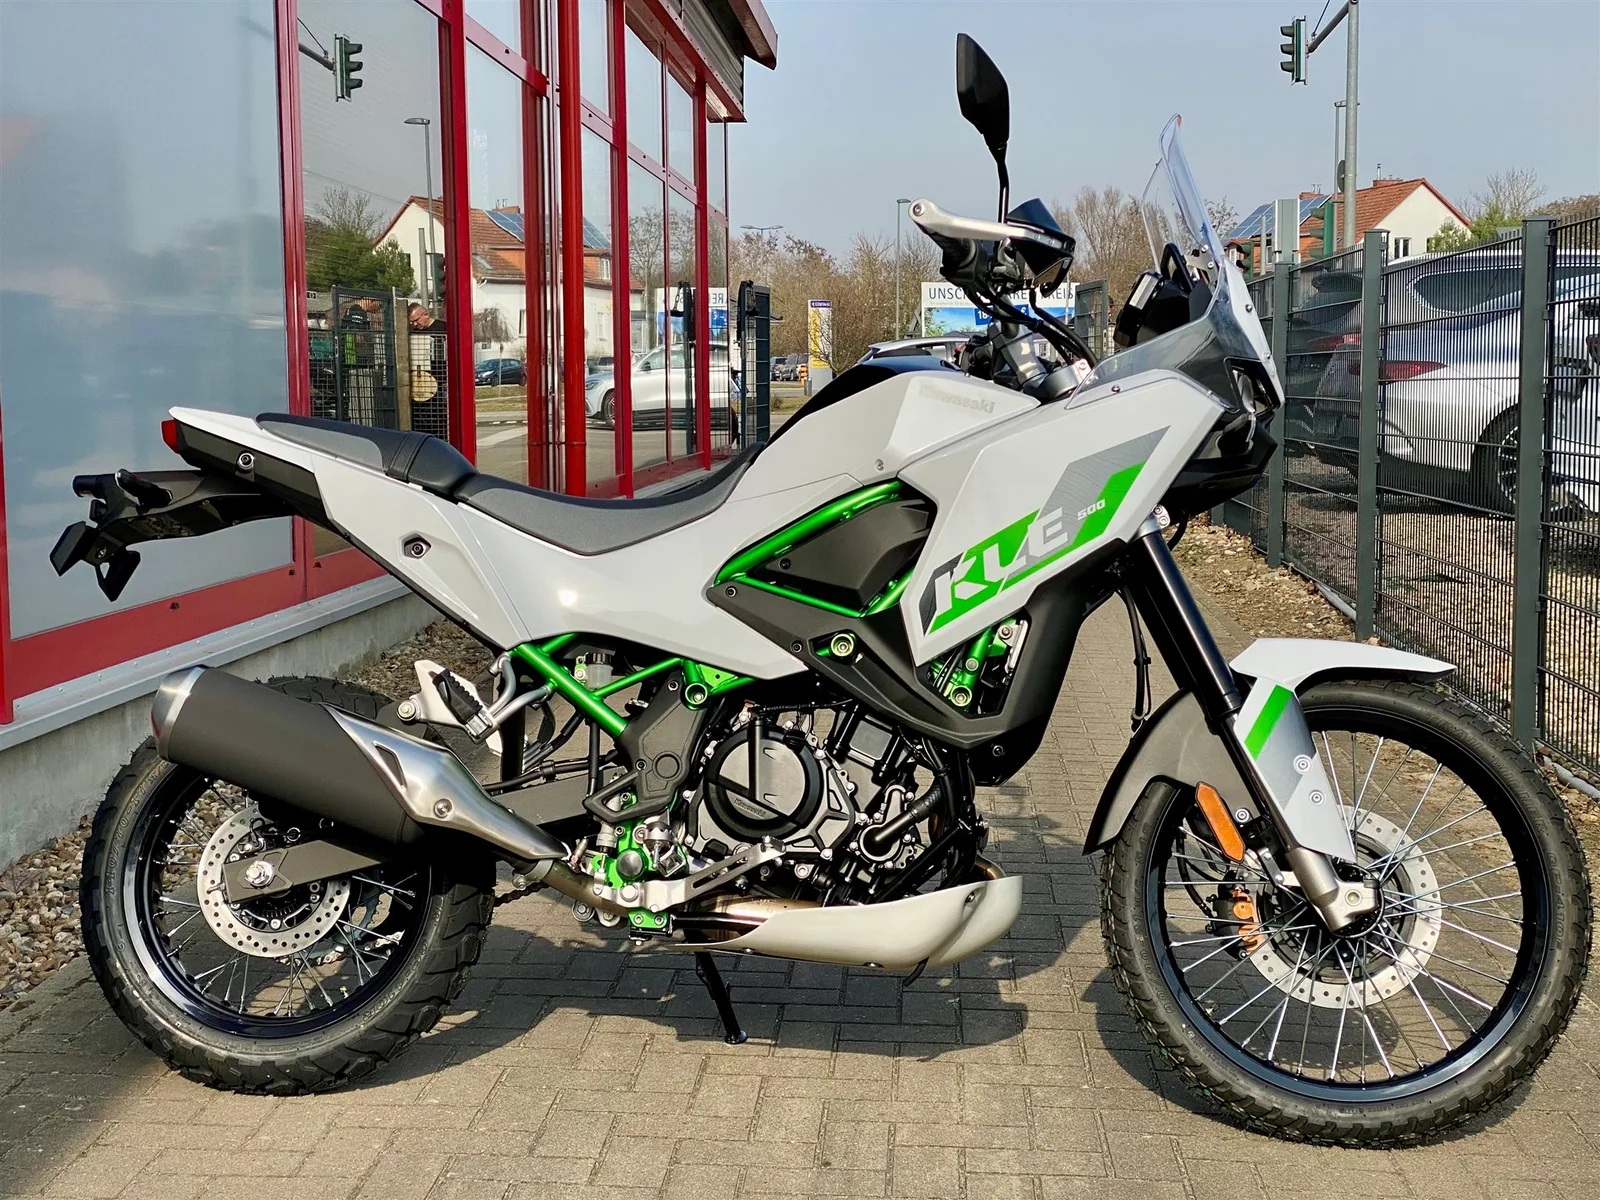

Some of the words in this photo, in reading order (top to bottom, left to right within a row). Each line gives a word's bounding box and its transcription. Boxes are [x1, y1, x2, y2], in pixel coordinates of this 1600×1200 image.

[919, 383, 996, 414] Kawasaki
[934, 507, 1068, 613] KLE
[1077, 499, 1106, 521] 500
